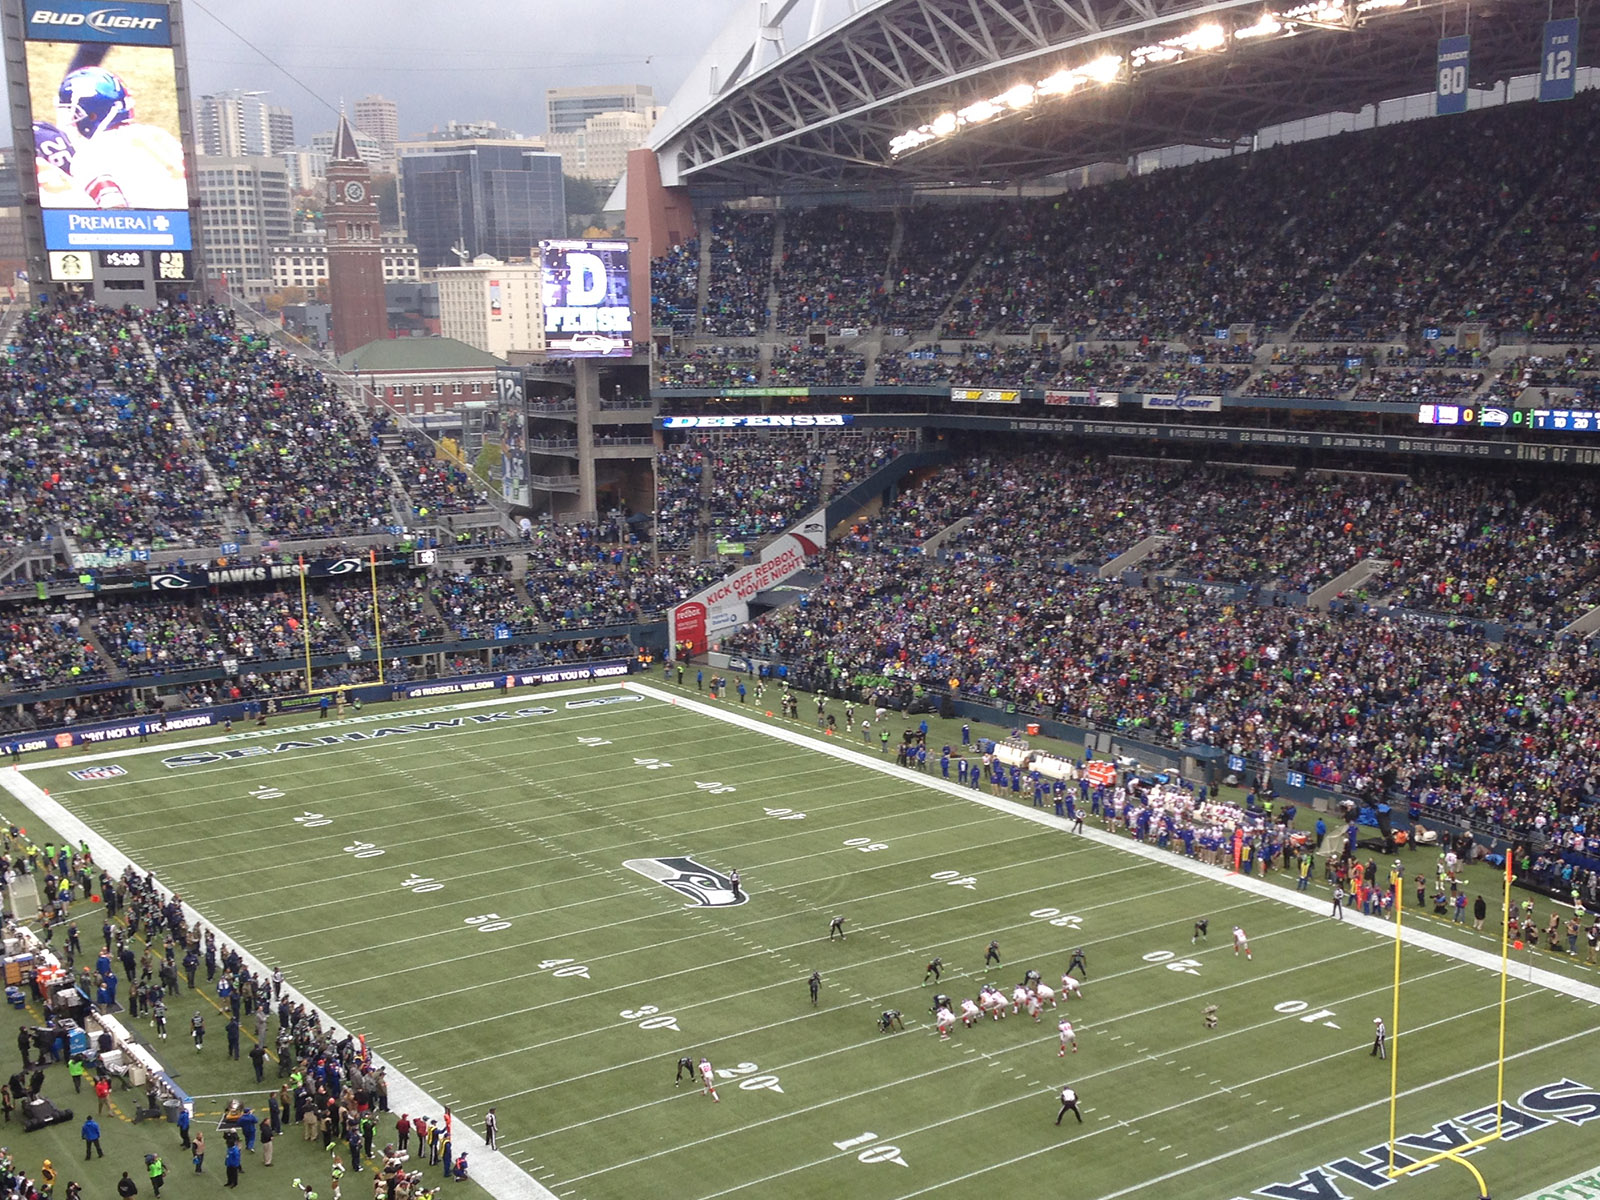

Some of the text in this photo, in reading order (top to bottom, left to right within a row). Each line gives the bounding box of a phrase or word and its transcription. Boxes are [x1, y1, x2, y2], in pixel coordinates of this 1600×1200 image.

[31, 9, 163, 30] BUD LIGHT
[1552, 35, 1569, 45] FAN
[1545, 50, 1572, 82] 12
[1439, 66, 1466, 96] 80
[68, 215, 146, 231] PREMERA
[952, 390, 1018, 401] SUBWAY SUBWAY
[1149, 398, 1213, 408] BUD LIGHT
[1463, 409, 1474, 421] 0
[1512, 411, 1523, 424] 0
[1517, 445, 1545, 460] RING
[1553, 448, 1569, 461] OF
[134, 550, 147, 561] 12
[224, 544, 237, 554] 12
[208, 564, 311, 584] HAWKS NEST
[706, 584, 732, 606] KICK
[733, 572, 753, 590] OFF
[754, 548, 796, 577] REDBOX
[737, 576, 770, 600] MOVIE
[676, 608, 701, 620] redbox
[498, 629, 509, 639] 12
[542, 673, 560, 683] NOT
[560, 671, 578, 680] YOU
[422, 684, 461, 696] RUSSELL
[461, 681, 494, 692] WILSON
[106, 727, 128, 739] NOT
[161, 705, 558, 770] SEAHAWKS
[1232, 757, 1243, 770] 12
[1291, 774, 1302, 787] 12
[248, 786, 286, 800] 10
[293, 813, 333, 828] 20
[343, 842, 386, 858] 30
[842, 837, 889, 853] 50
[400, 876, 445, 893] 40
[929, 869, 978, 887] 40
[463, 913, 512, 932] 50
[1029, 907, 1084, 928] 30
[537, 958, 590, 978] 40
[1141, 949, 1204, 975] 20
[619, 1005, 679, 1031] 30
[1273, 999, 1338, 1025] 10
[714, 1061, 781, 1092] 20
[832, 1131, 903, 1165] 10
